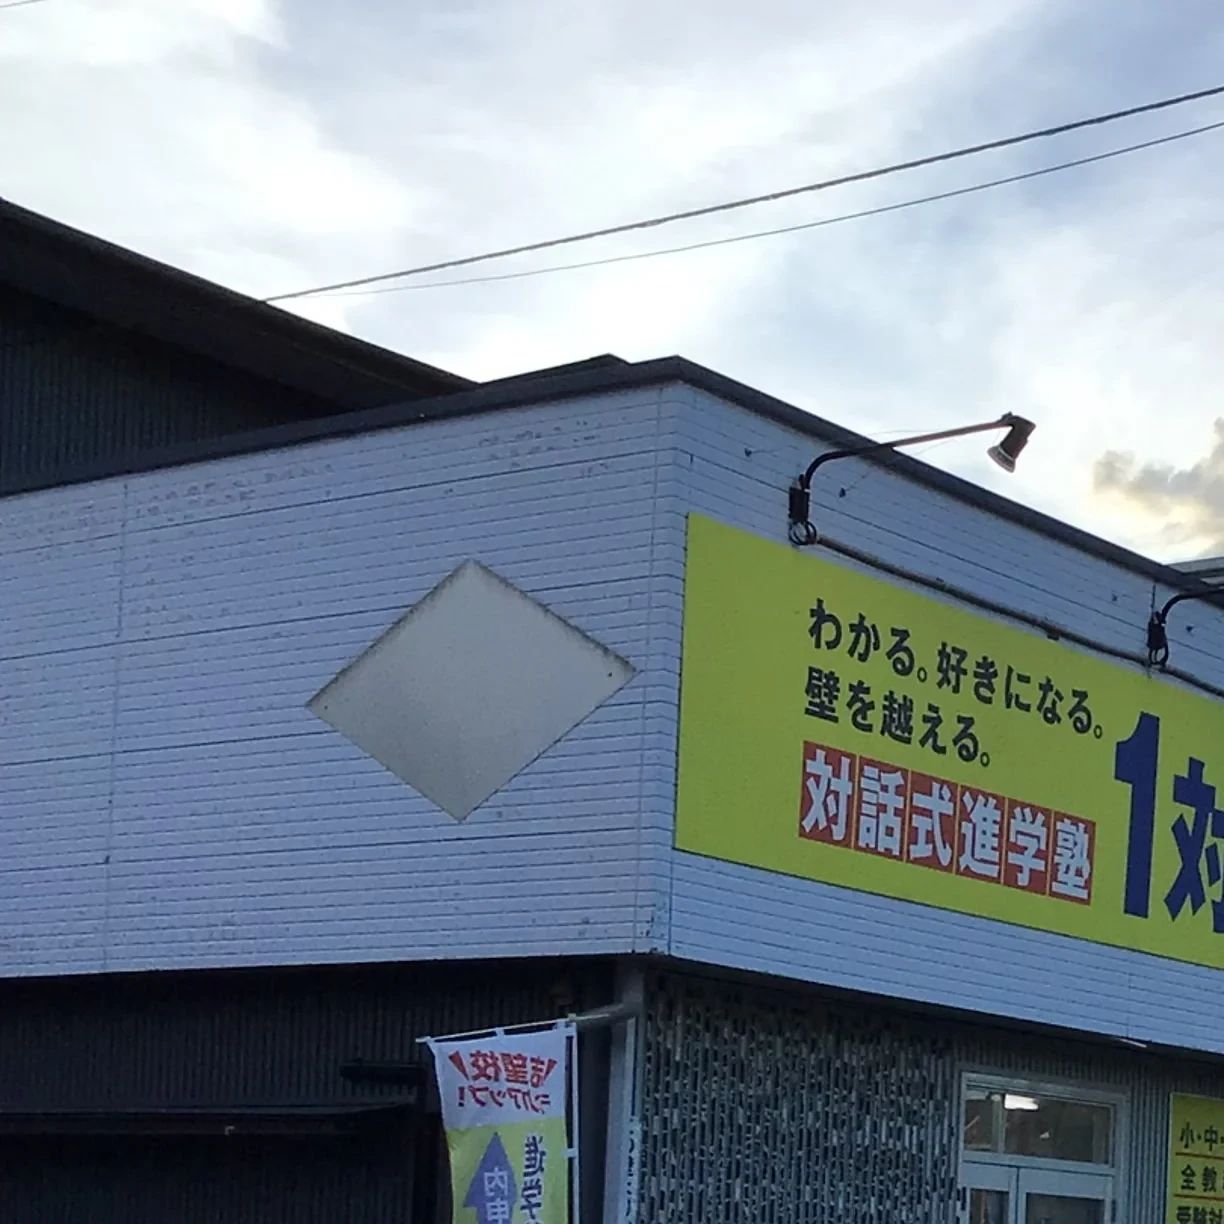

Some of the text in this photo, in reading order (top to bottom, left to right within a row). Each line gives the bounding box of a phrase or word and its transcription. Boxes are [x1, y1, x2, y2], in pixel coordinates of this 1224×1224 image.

[804, 666, 990, 768] 壁を越える。
[808, 598, 1103, 739] わかる。好きになる。
[801, 747, 1091, 901] 対話式進学塾
